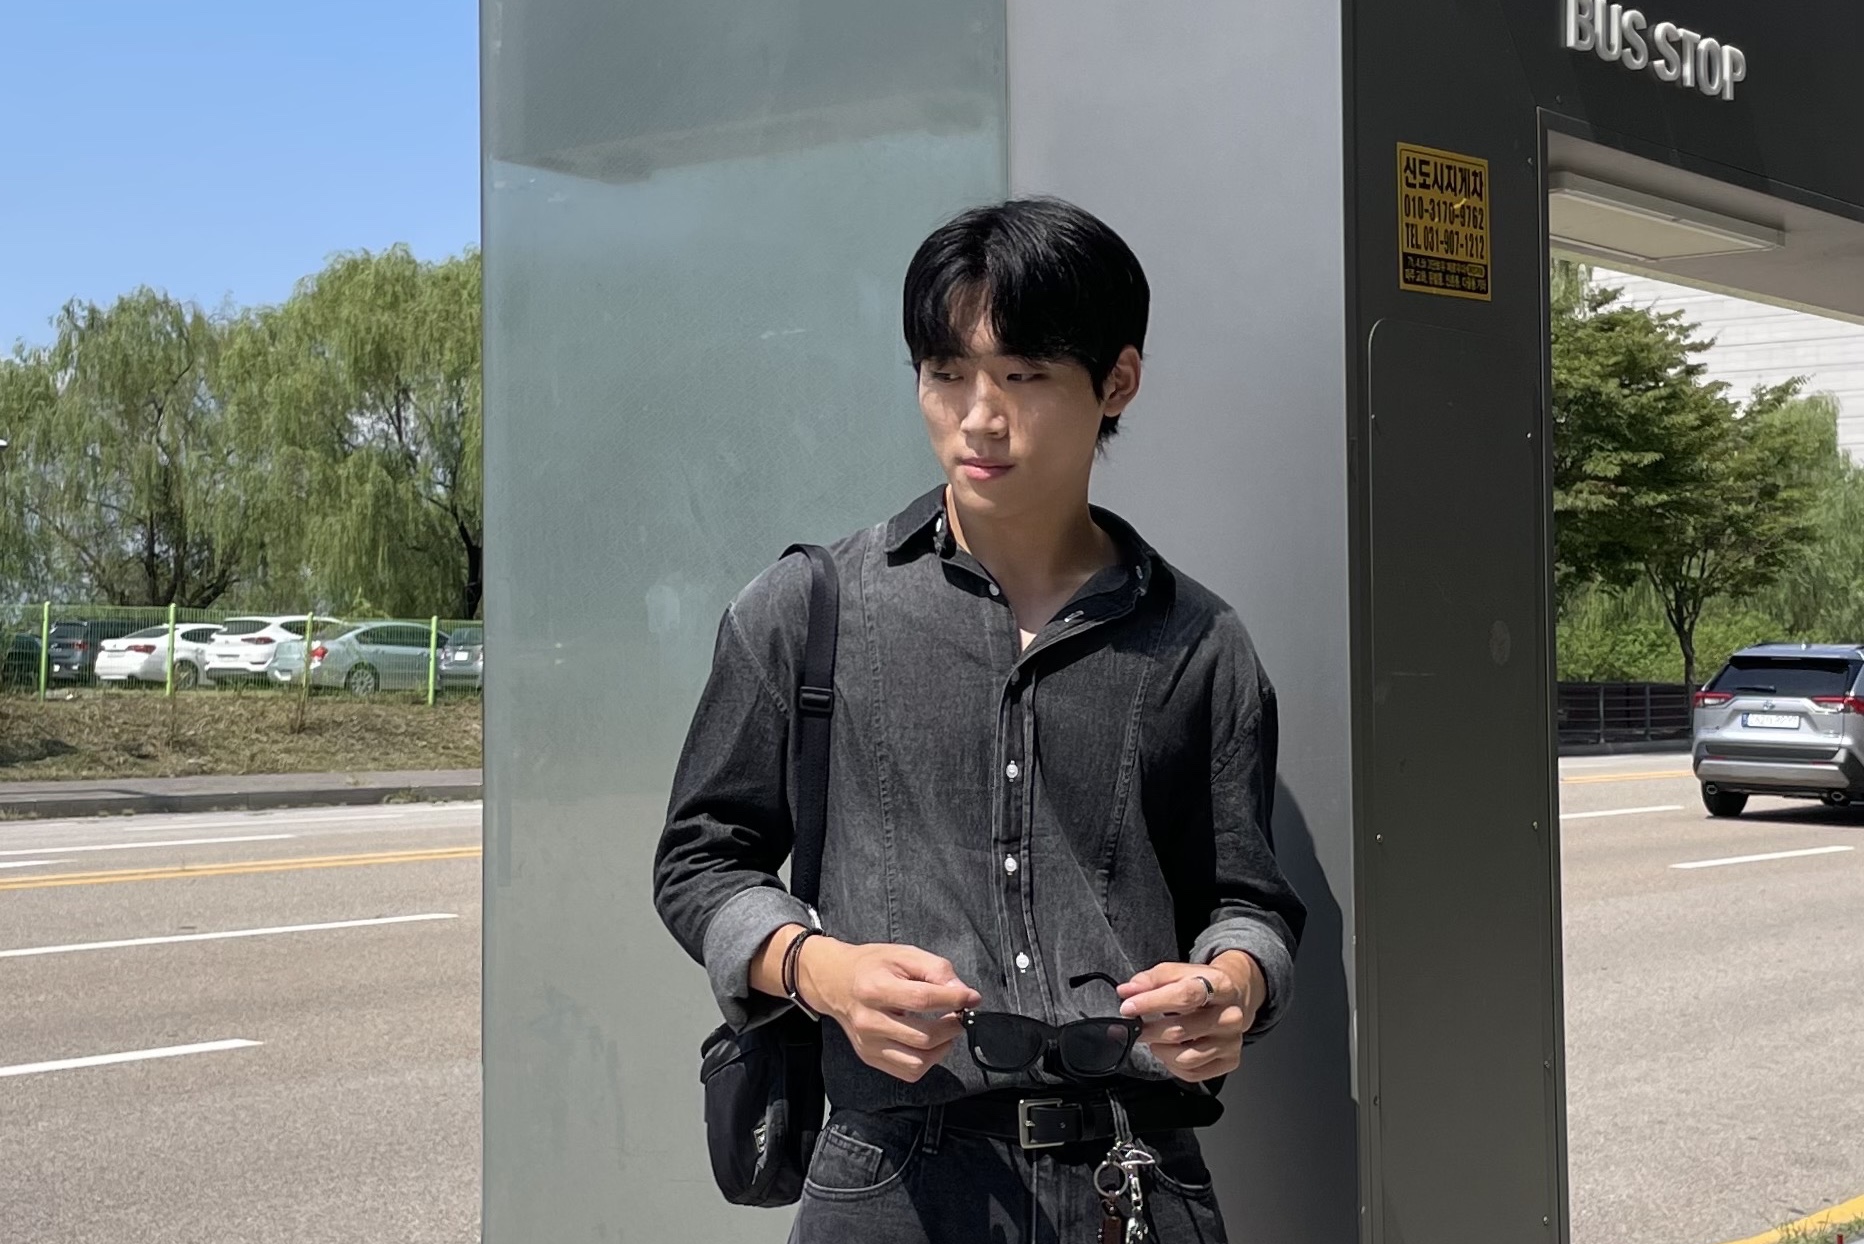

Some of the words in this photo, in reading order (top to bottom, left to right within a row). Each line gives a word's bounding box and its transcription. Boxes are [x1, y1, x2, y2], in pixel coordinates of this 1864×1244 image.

[1566, 0, 1649, 70] BUS
[1653, 22, 1747, 100] STOP
[1404, 156, 1484, 203] 신도시지게차
[1404, 193, 1484, 230] 010-3170-9762
[1423, 225, 1485, 260] 031-907-1212
